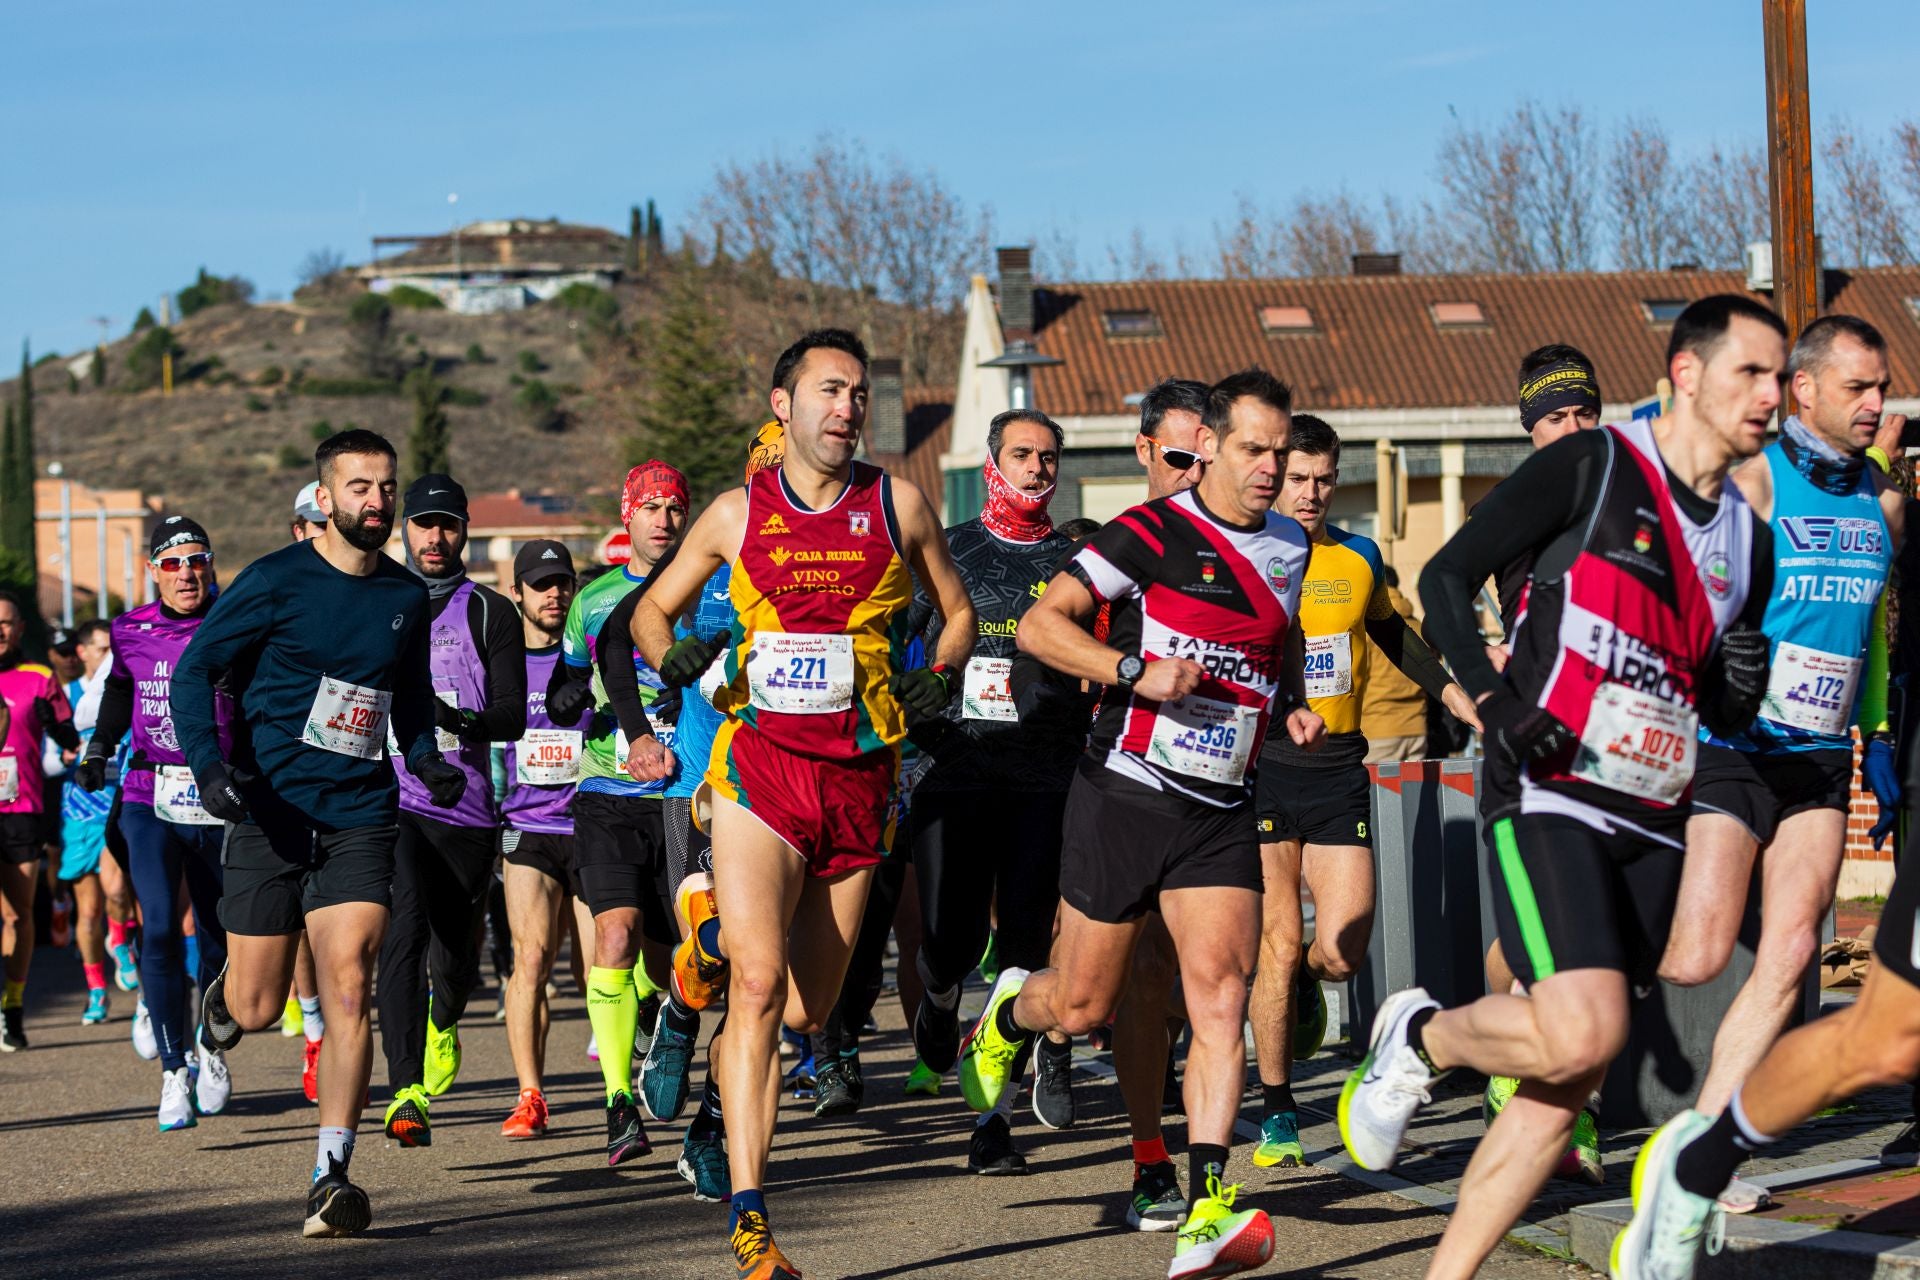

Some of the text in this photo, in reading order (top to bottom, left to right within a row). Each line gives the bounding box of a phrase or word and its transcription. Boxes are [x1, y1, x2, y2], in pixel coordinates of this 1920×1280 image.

[1532, 370, 1588, 391] RUNNERS
[759, 527, 791, 536] austral
[1840, 530, 1882, 553] ULSA
[607, 544, 631, 559] STO
[793, 551, 866, 562] CAJA RURAL
[792, 569, 840, 583] VINO
[803, 584, 856, 596] TORO
[1780, 574, 1884, 605] ATLETISM
[790, 657, 826, 680] 271
[1304, 652, 1335, 673] 248
[1815, 675, 1845, 700] 172
[350, 706, 385, 729] 1207
[1199, 722, 1237, 750] 336
[1640, 726, 1687, 763] 1076
[538, 745, 573, 761] 1034
[224, 785, 241, 807] KIPSTA
